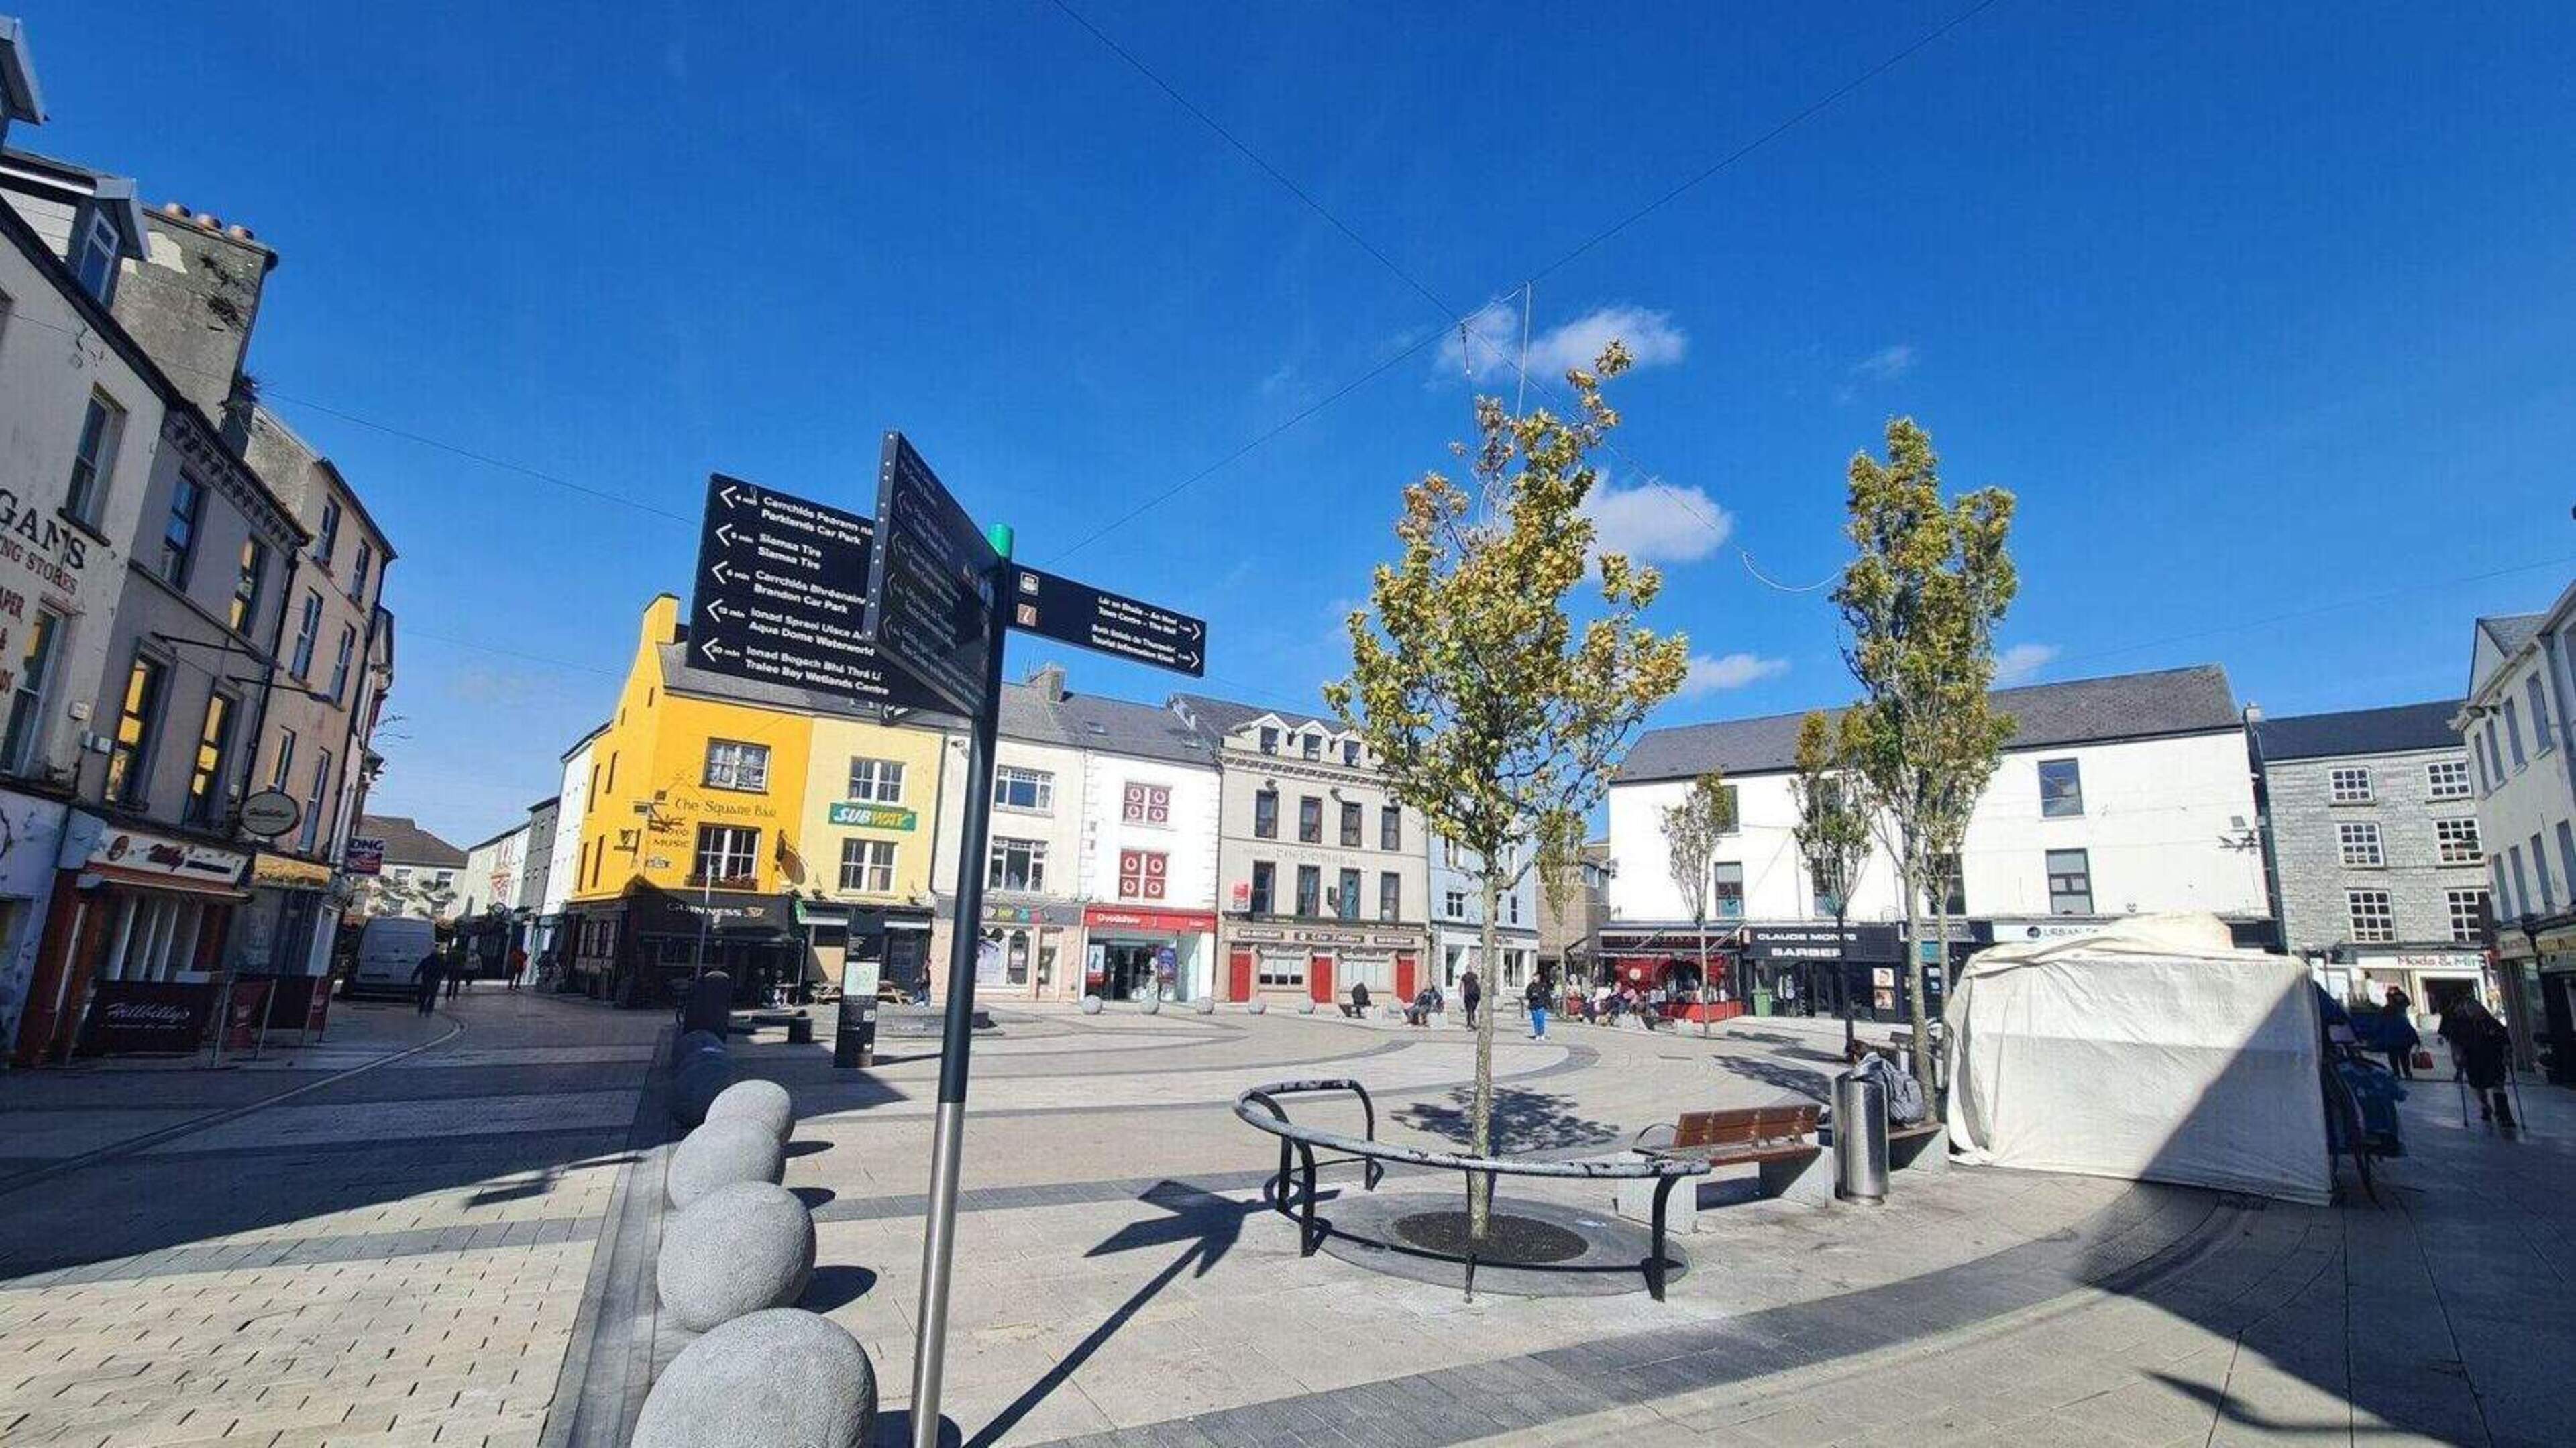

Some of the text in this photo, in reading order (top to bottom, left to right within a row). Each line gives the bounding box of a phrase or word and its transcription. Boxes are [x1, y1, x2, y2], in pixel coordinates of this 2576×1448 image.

[761, 508, 861, 545] Parklands Car Park
[759, 533, 799, 552] Siamsa
[757, 546, 798, 565] Siamsa
[754, 583, 848, 614] Brandon Car Park
[729, 609, 745, 619] min
[751, 607, 783, 622] Ionad
[822, 624, 850, 638] Uisce
[749, 620, 875, 657] Aqua Dome Waterworld
[724, 648, 740, 658] min
[747, 646, 779, 661] Ionad
[745, 659, 890, 695] Tralee Bay Wetlands Centre
[704, 800, 752, 816] Square
[833, 807, 904, 828] SUBWAY
